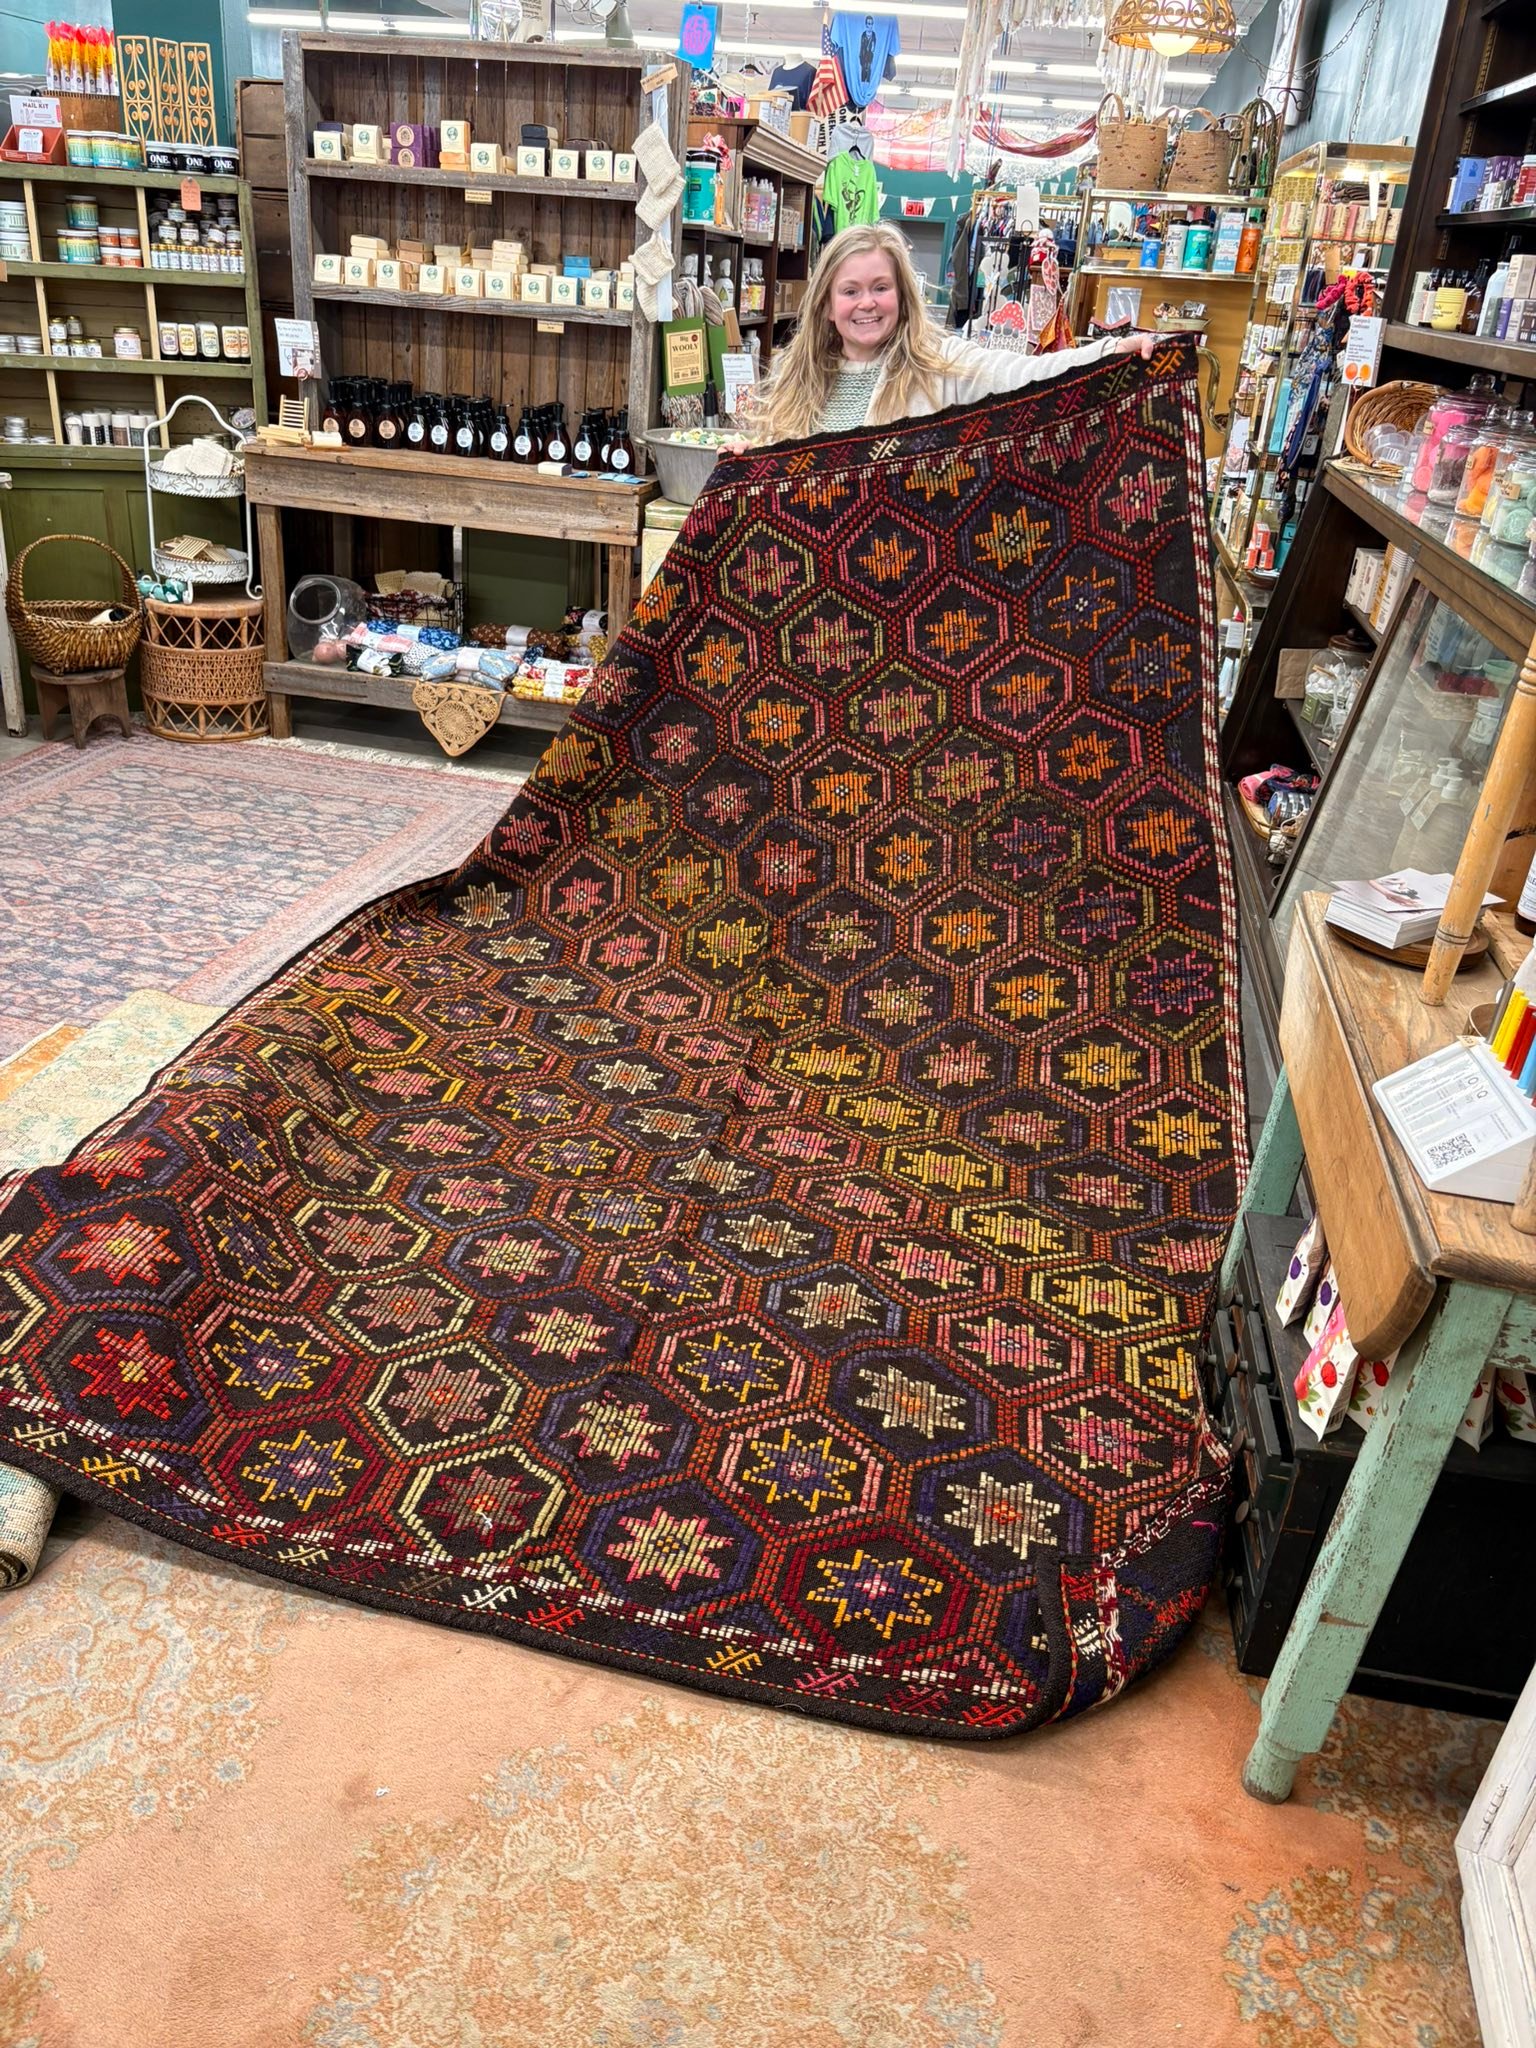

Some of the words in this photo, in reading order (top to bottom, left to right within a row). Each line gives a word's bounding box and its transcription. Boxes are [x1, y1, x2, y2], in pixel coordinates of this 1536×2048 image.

[150, 154, 171, 164] ONE.
[213, 159, 235, 169] ONE.
[906, 201, 924, 215] EXIT
[672, 343, 699, 352] WOOLY
